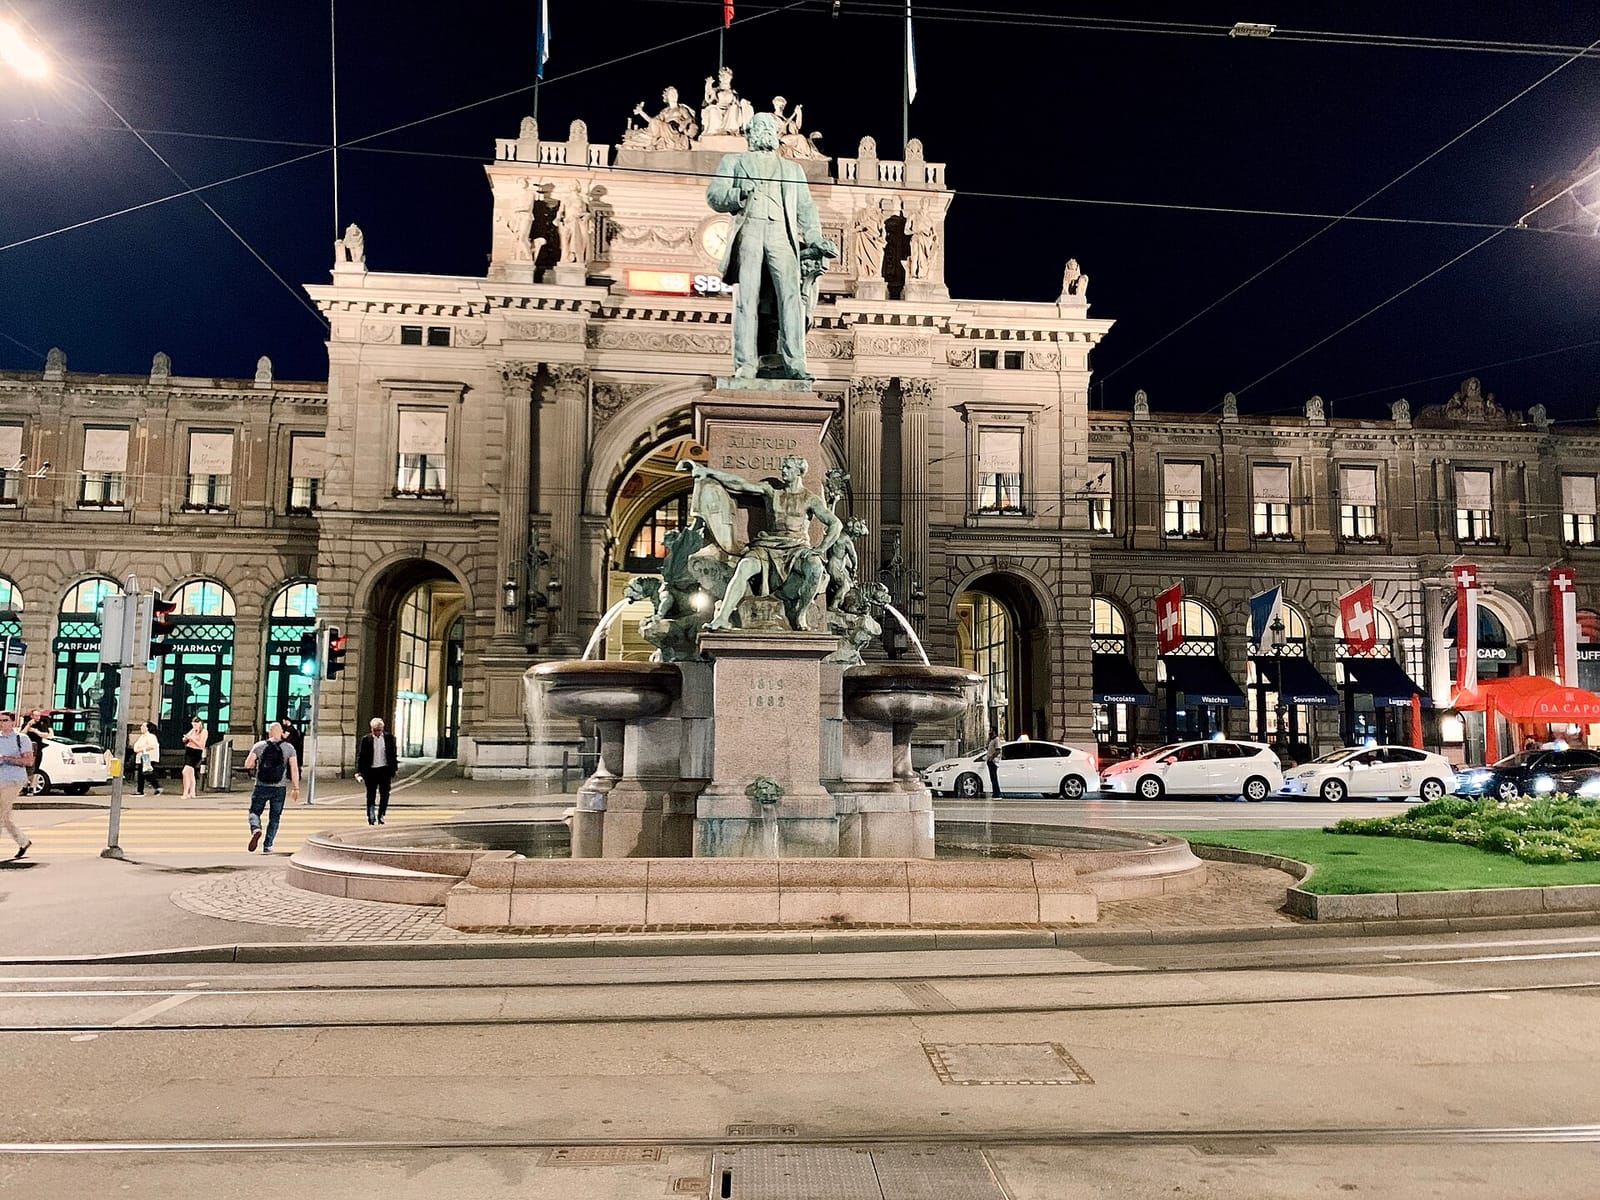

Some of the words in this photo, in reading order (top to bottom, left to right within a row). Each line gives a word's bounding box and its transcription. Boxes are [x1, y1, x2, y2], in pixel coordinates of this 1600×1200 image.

[728, 438, 797, 450] ALFRED
[1477, 648, 1507, 659] CAPO
[748, 695, 786, 707] 1882
[1103, 695, 1136, 703] Chocolate
[1201, 696, 1229, 704] Watches
[1540, 703, 1558, 713] DA
[1563, 703, 1600, 714] CAPO
